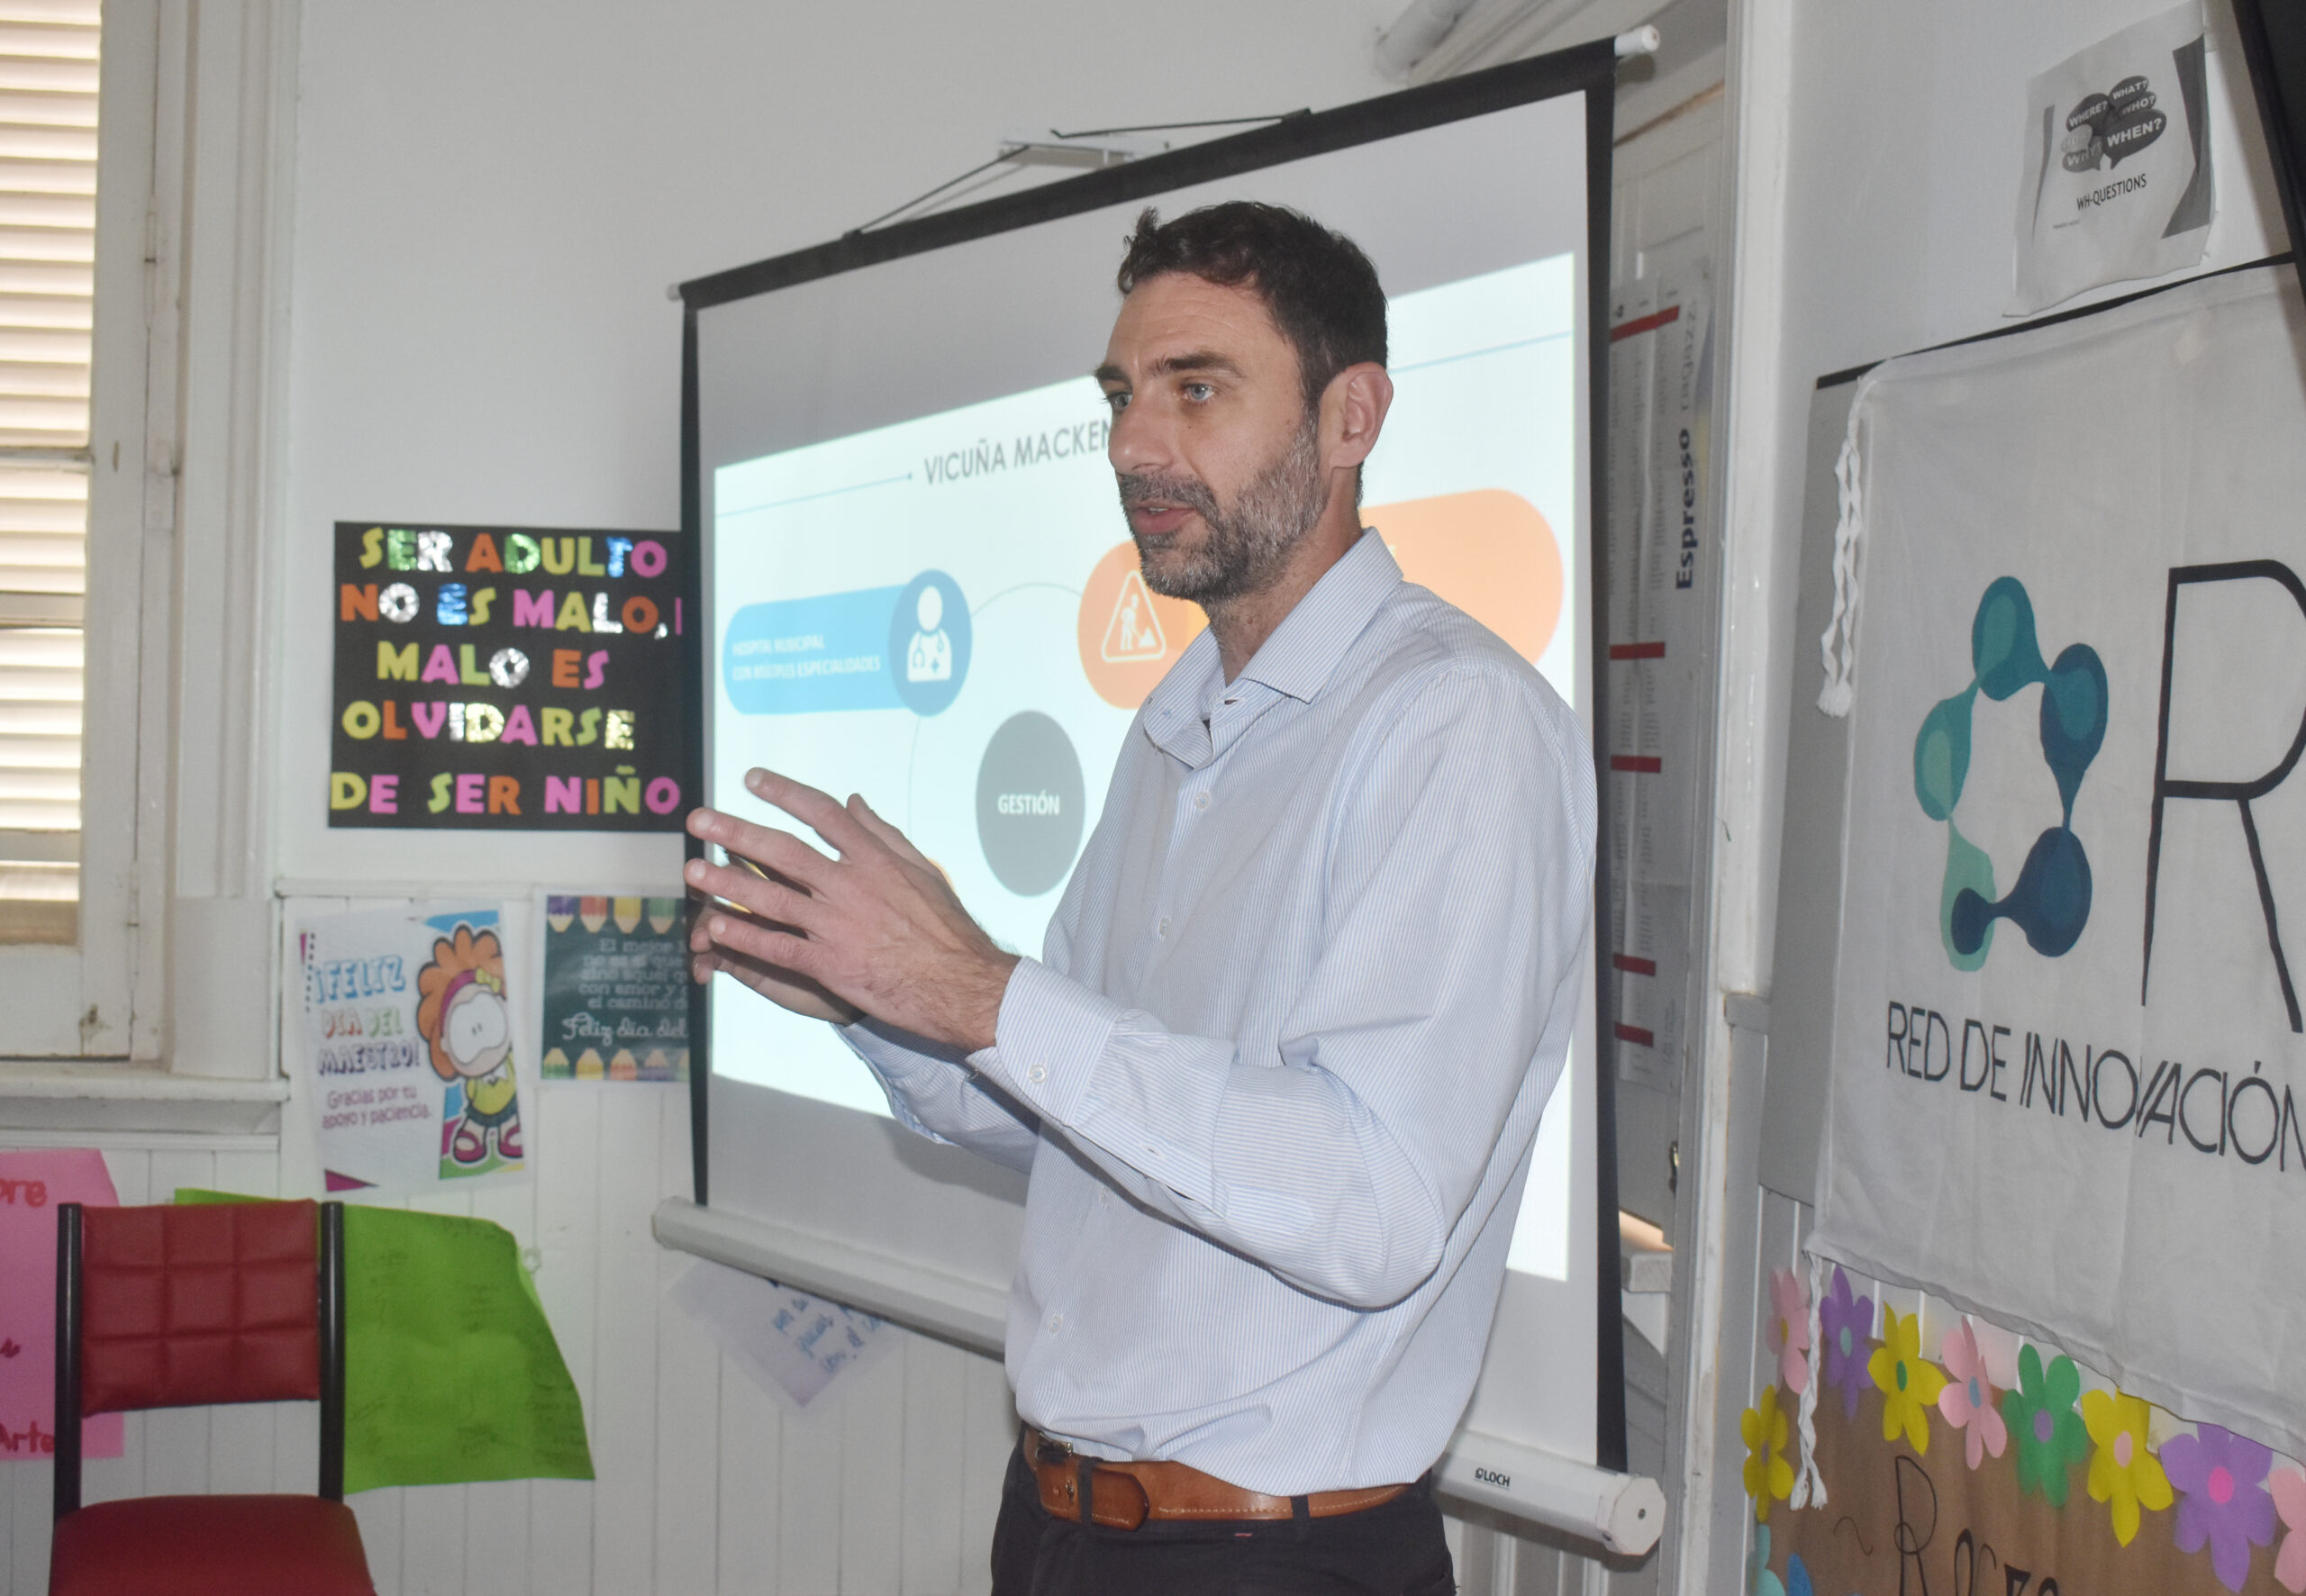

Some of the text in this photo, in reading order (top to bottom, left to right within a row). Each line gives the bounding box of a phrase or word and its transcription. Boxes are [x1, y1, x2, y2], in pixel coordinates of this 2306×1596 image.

[2112, 79, 2147, 100] WHAT?
[2122, 95, 2156, 114] WHO?
[2069, 101, 2108, 127] WHERE?
[2107, 118, 2162, 147] WHEN?
[2076, 173, 2147, 211] WH-QUESTIONS
[924, 438, 1007, 485] VICUÑA
[1675, 428, 1698, 589] Espresso
[359, 526, 667, 578] SER ADULTO
[340, 582, 420, 623] NO
[436, 583, 496, 625] ES
[513, 589, 667, 639] MALO,
[377, 640, 610, 690] MALO ES
[797, 655, 882, 677] ESPECIALIDADES
[341, 700, 635, 750] OLVIDARSE
[330, 765, 681, 814] DE SER NIÑO
[997, 789, 1060, 815] GESTIÓN
[1886, 1001, 1950, 1082] RED
[1960, 1019, 2011, 1102] DE
